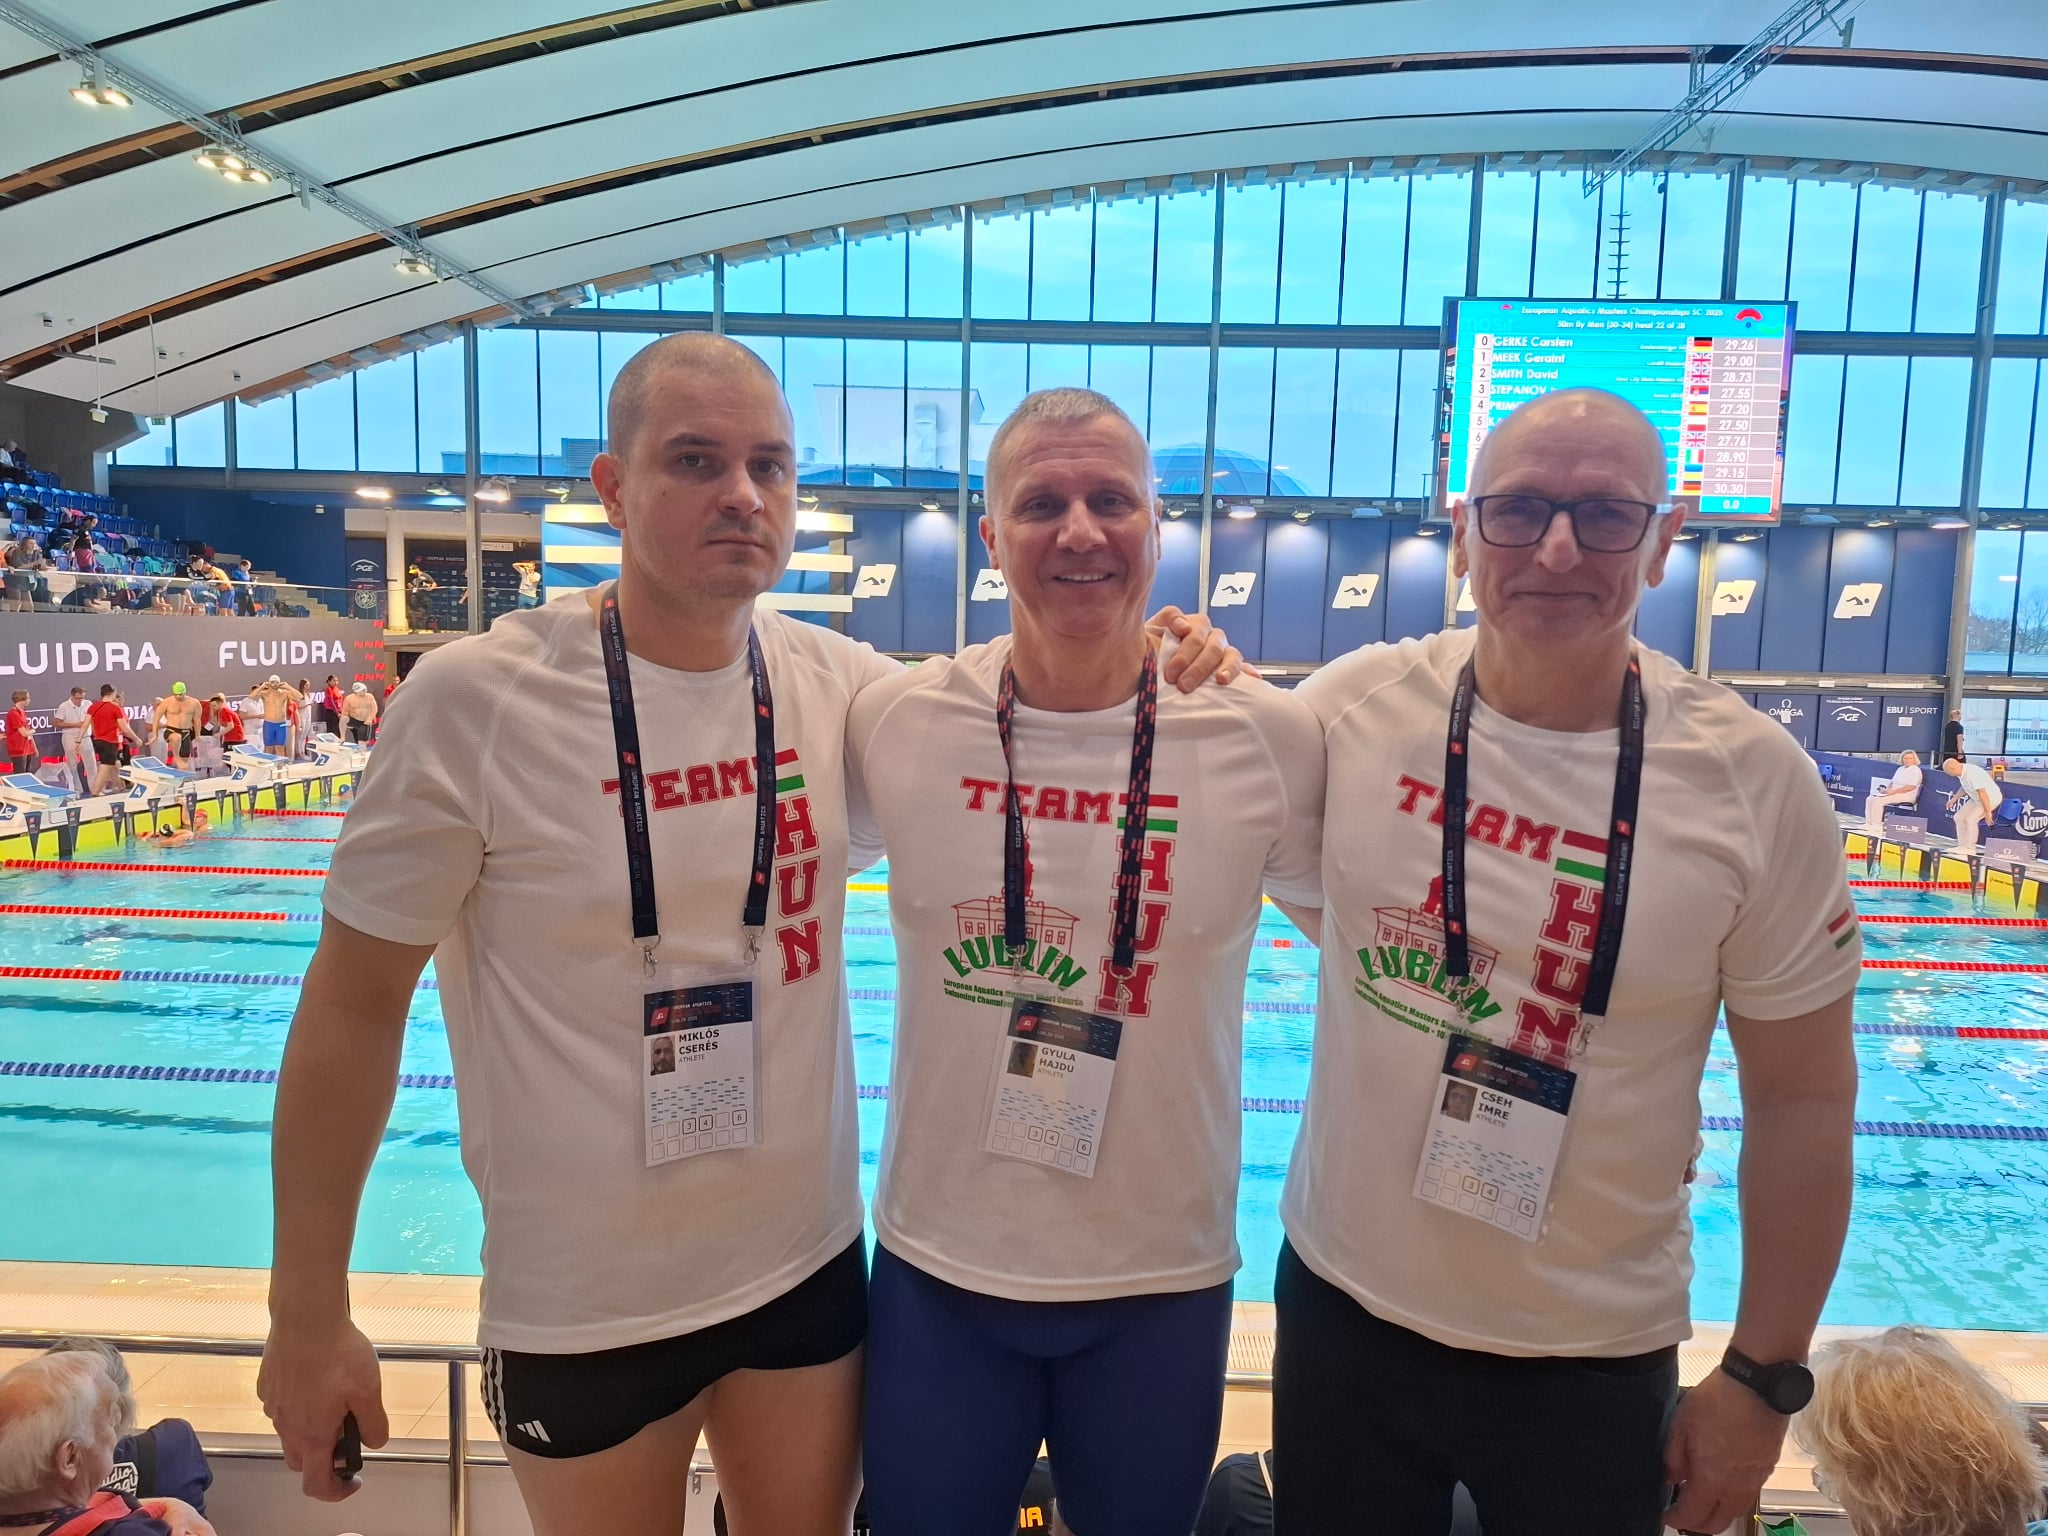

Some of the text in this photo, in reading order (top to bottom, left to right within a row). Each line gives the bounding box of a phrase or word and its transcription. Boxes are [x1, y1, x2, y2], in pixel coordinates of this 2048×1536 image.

[1521, 306, 1558, 315] European
[1561, 307, 1594, 316] Aquatics
[1598, 308, 1628, 316] Masters
[1630, 308, 1690, 317] Championships
[1692, 308, 1702, 316] SC
[1587, 320, 1604, 328] Men
[1482, 336, 1488, 346] 0
[1493, 336, 1573, 347] GERKE Carsten
[1725, 340, 1754, 350] 29.26
[1482, 352, 1486, 362] 1
[1492, 352, 1565, 363] MEEK Geraint
[1724, 356, 1753, 366] 29.00
[1480, 368, 1486, 378] 2
[1491, 369, 1558, 379] SMITH David
[1722, 372, 1751, 382] 28.73
[1479, 384, 1485, 394] 3
[1490, 385, 1546, 394] STEPANOV
[1721, 388, 1750, 398] 27.55
[1478, 400, 1484, 410] 4
[1720, 404, 1750, 414] 27.20
[1477, 416, 1482, 426] 5
[1719, 420, 1748, 430] 27.50
[1476, 433, 1482, 442] 6
[1718, 436, 1746, 446] 27.76
[1716, 452, 1746, 462] 28.90
[1715, 468, 1744, 478] 29.15
[1714, 484, 1744, 494] 30.30
[356, 564, 374, 572] PGE
[609, 611, 618, 634] UROPEAN
[219, 640, 346, 668] FLUIDRA
[1886, 706, 1904, 714] EBU
[1836, 713, 1860, 722] PGE
[1452, 712, 1460, 737] UROPEAN
[320, 756, 326, 765] 2
[238, 770, 244, 778] 3
[135, 787, 142, 797] 4
[631, 769, 644, 833] UROPEAN AQUATICS
[2024, 814, 2048, 830] LOTTO
[756, 838, 764, 864] UROPEAN
[1620, 842, 1628, 871] UROPEAN
[774, 793, 822, 986] HUN
[1094, 834, 1176, 1017] HUN
[1506, 878, 1604, 1070] HUN
[944, 977, 973, 994] European
[974, 984, 1004, 997] Aquatics
[944, 987, 976, 1004] Swimming
[1379, 992, 1408, 1011] Aquatics
[1408, 1004, 1440, 1026] Masters
[1380, 1005, 1430, 1034] Championship
[678, 1028, 720, 1043] MIKLÓS
[678, 1040, 718, 1055] CSERÉS
[678, 1054, 706, 1064] ATHLETE
[1042, 1047, 1076, 1062] GYULA
[1040, 1057, 1074, 1073] HAJDU
[1038, 1068, 1064, 1079] ATHLETE
[1481, 1090, 1512, 1109] CSEH
[1478, 1104, 1510, 1121] IMRE
[686, 1122, 692, 1130] 3
[1475, 1114, 1506, 1129] ATHLETE
[1032, 1130, 1038, 1138] 3
[1049, 1134, 1054, 1142] 4
[1468, 1181, 1530, 1212] 3 4 6
[100, 1465, 132, 1488] udio
